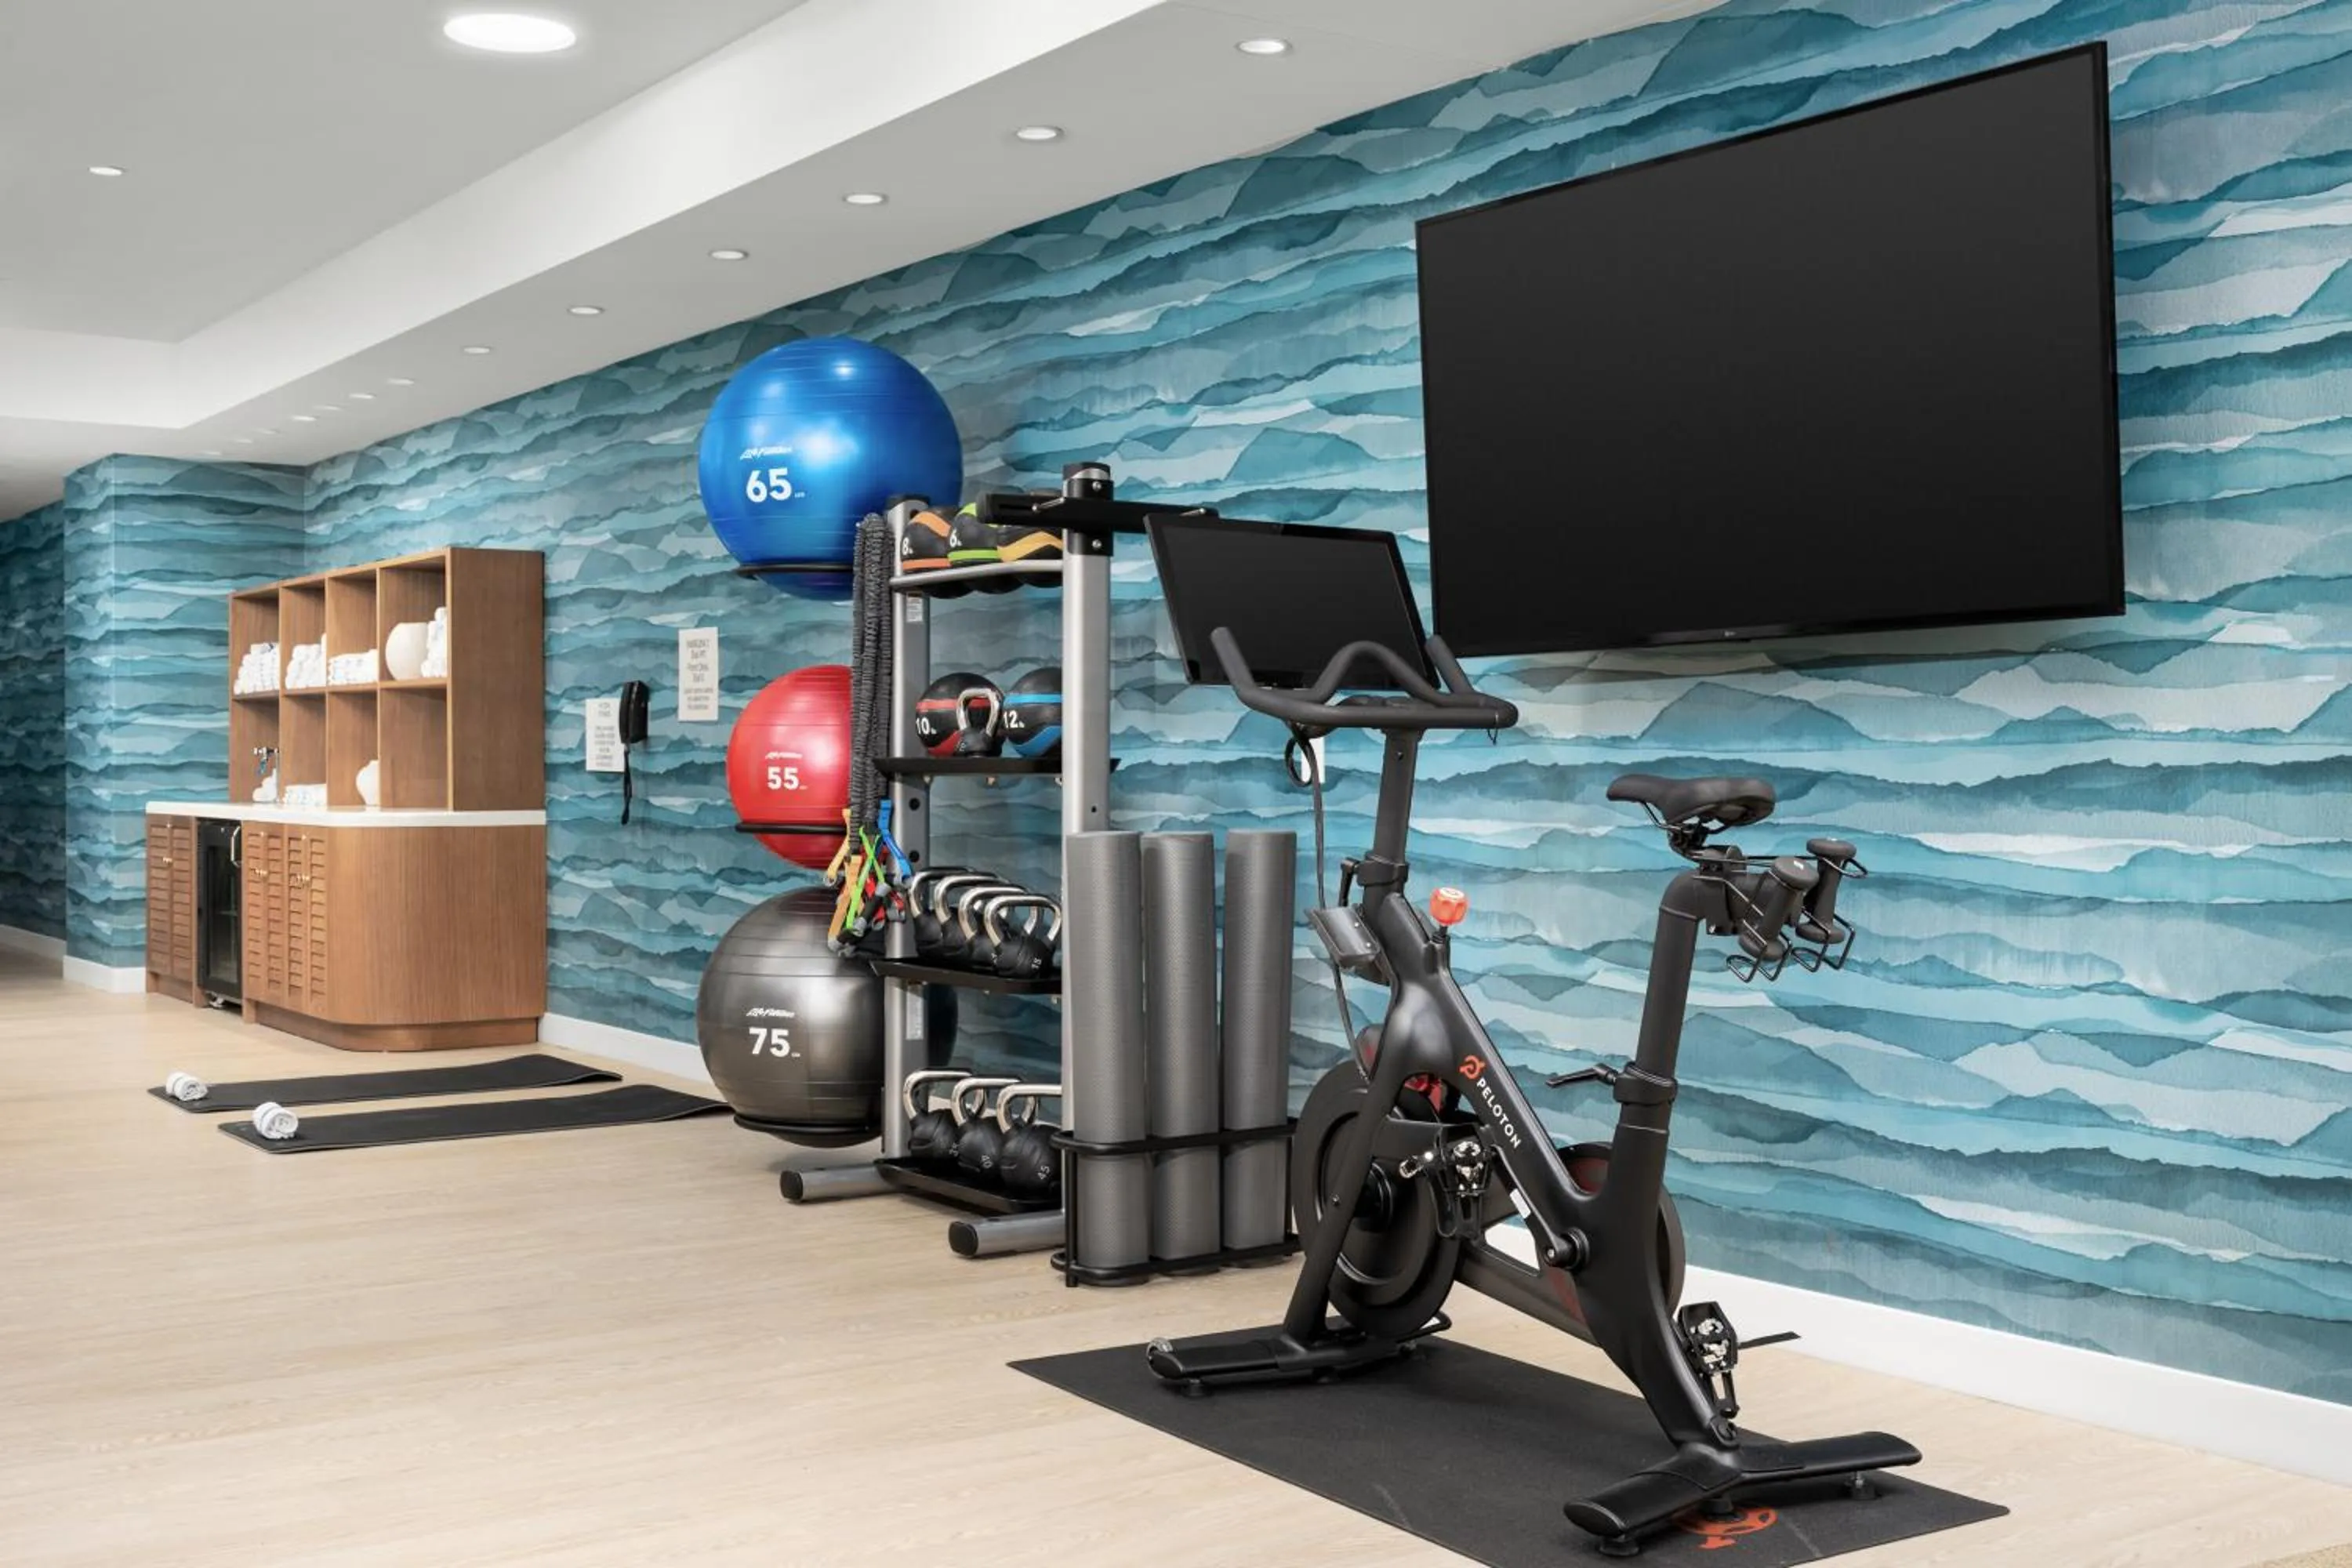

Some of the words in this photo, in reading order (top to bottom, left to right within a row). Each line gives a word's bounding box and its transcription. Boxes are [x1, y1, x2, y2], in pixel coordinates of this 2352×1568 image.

[746, 467, 792, 503] 65
[902, 537, 909, 556] 8
[949, 528, 957, 548] 6
[916, 717, 931, 735] 10
[1004, 710, 1018, 728] 12
[768, 766, 800, 790] 55
[749, 1027, 790, 1058] 75
[1476, 1077, 1521, 1149] PELOTON
[1037, 1166, 1050, 1180] 45
